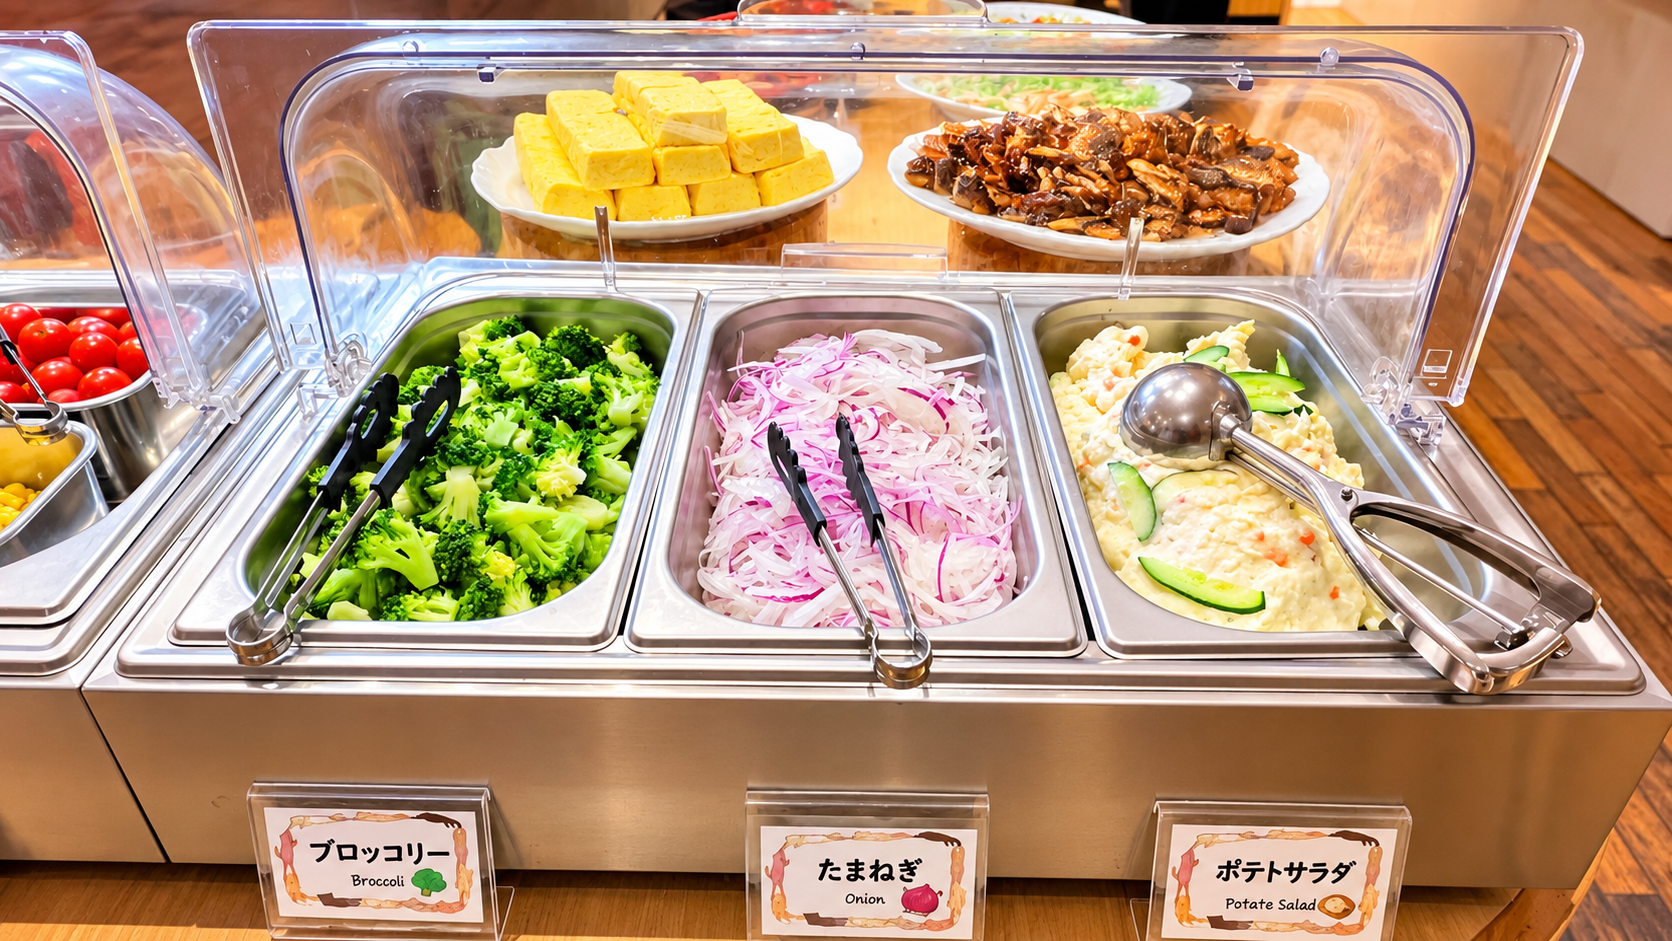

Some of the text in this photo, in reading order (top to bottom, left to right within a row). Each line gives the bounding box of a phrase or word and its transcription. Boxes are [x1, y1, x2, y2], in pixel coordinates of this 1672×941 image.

[309, 838, 450, 865] ブロッコリー
[818, 857, 923, 883] たまねぎ
[1215, 858, 1357, 885] ポテトサラダ
[350, 874, 405, 888] Broccoli
[845, 892, 886, 905] Onion
[1225, 897, 1317, 911] Potate Salad
